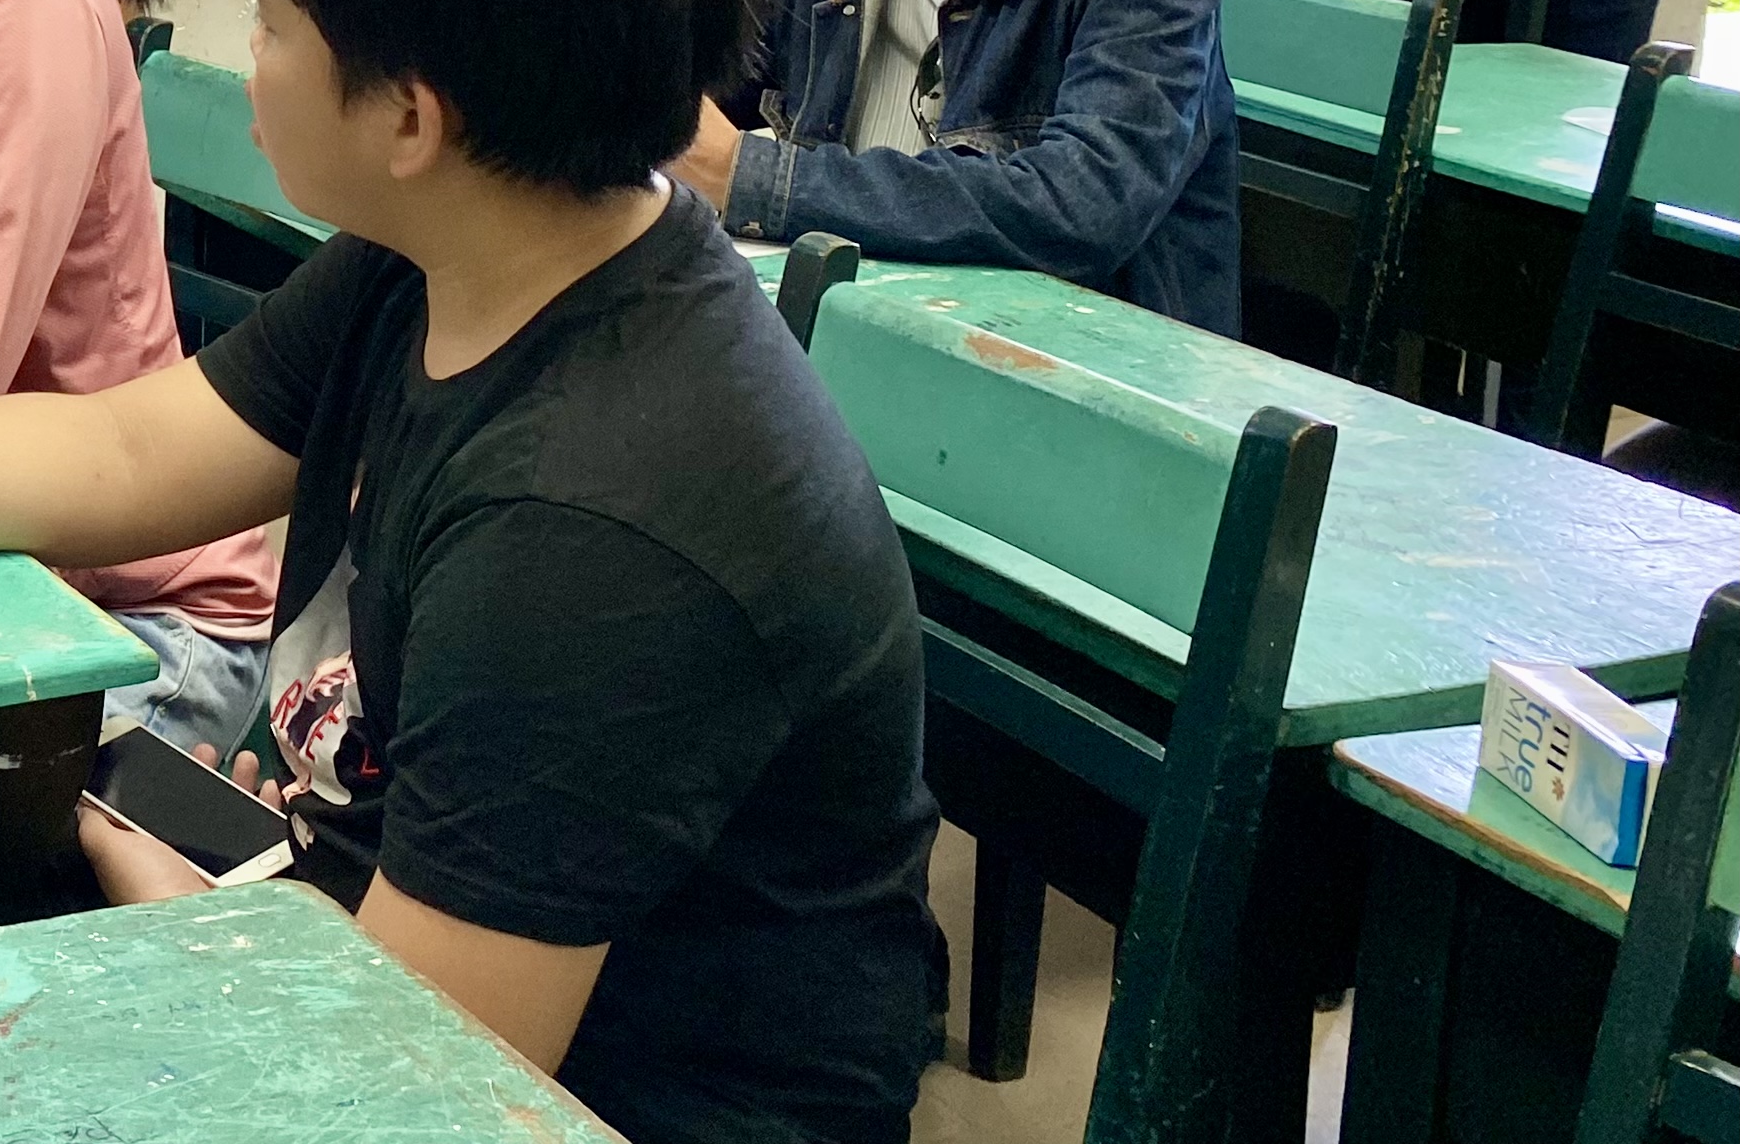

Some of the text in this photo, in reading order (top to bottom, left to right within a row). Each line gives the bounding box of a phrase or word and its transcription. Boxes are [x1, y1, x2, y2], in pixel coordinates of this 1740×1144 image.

[1496, 686, 1528, 782] MILK
[1516, 702, 1552, 793] true
[1546, 723, 1572, 773] TH
